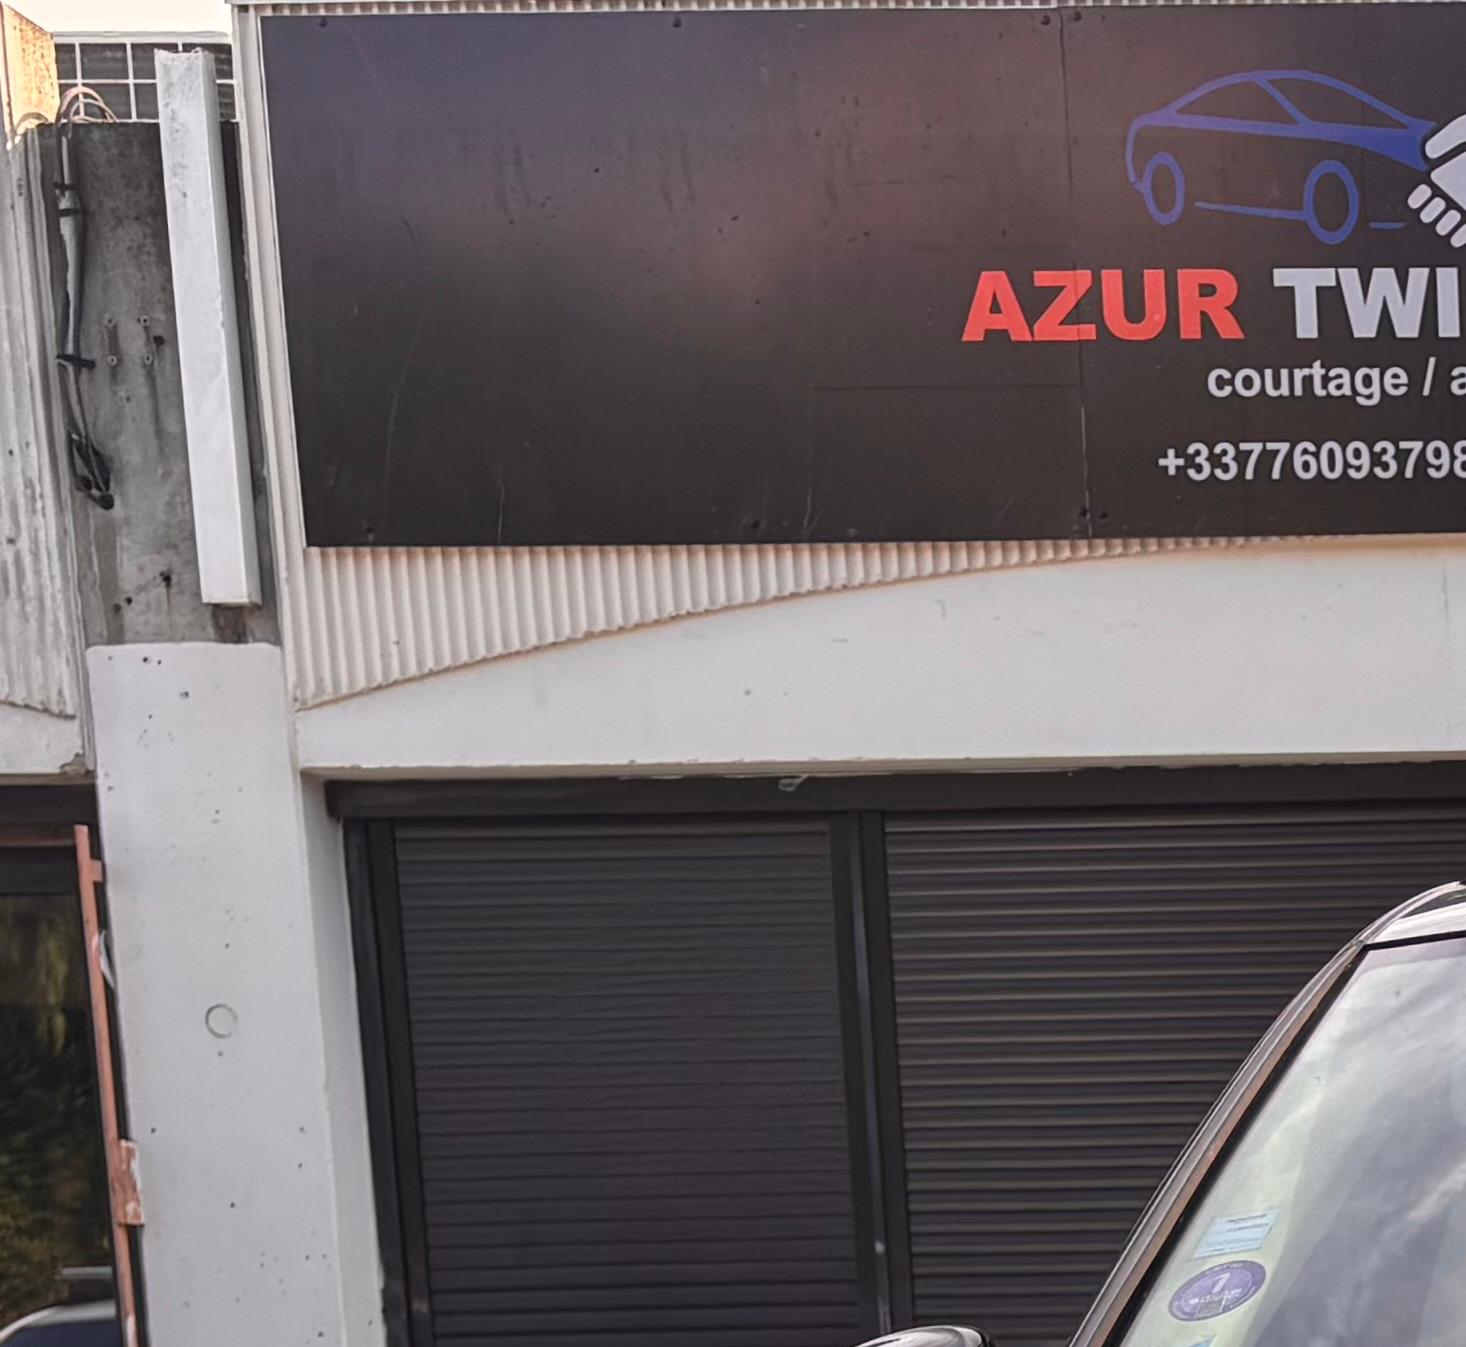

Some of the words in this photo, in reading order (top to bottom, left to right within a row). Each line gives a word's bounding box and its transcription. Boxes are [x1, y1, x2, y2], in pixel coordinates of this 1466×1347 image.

[963, 268, 1244, 343] AZUR
[1207, 360, 1409, 406] courtage
[1422, 356, 1436, 397] /
